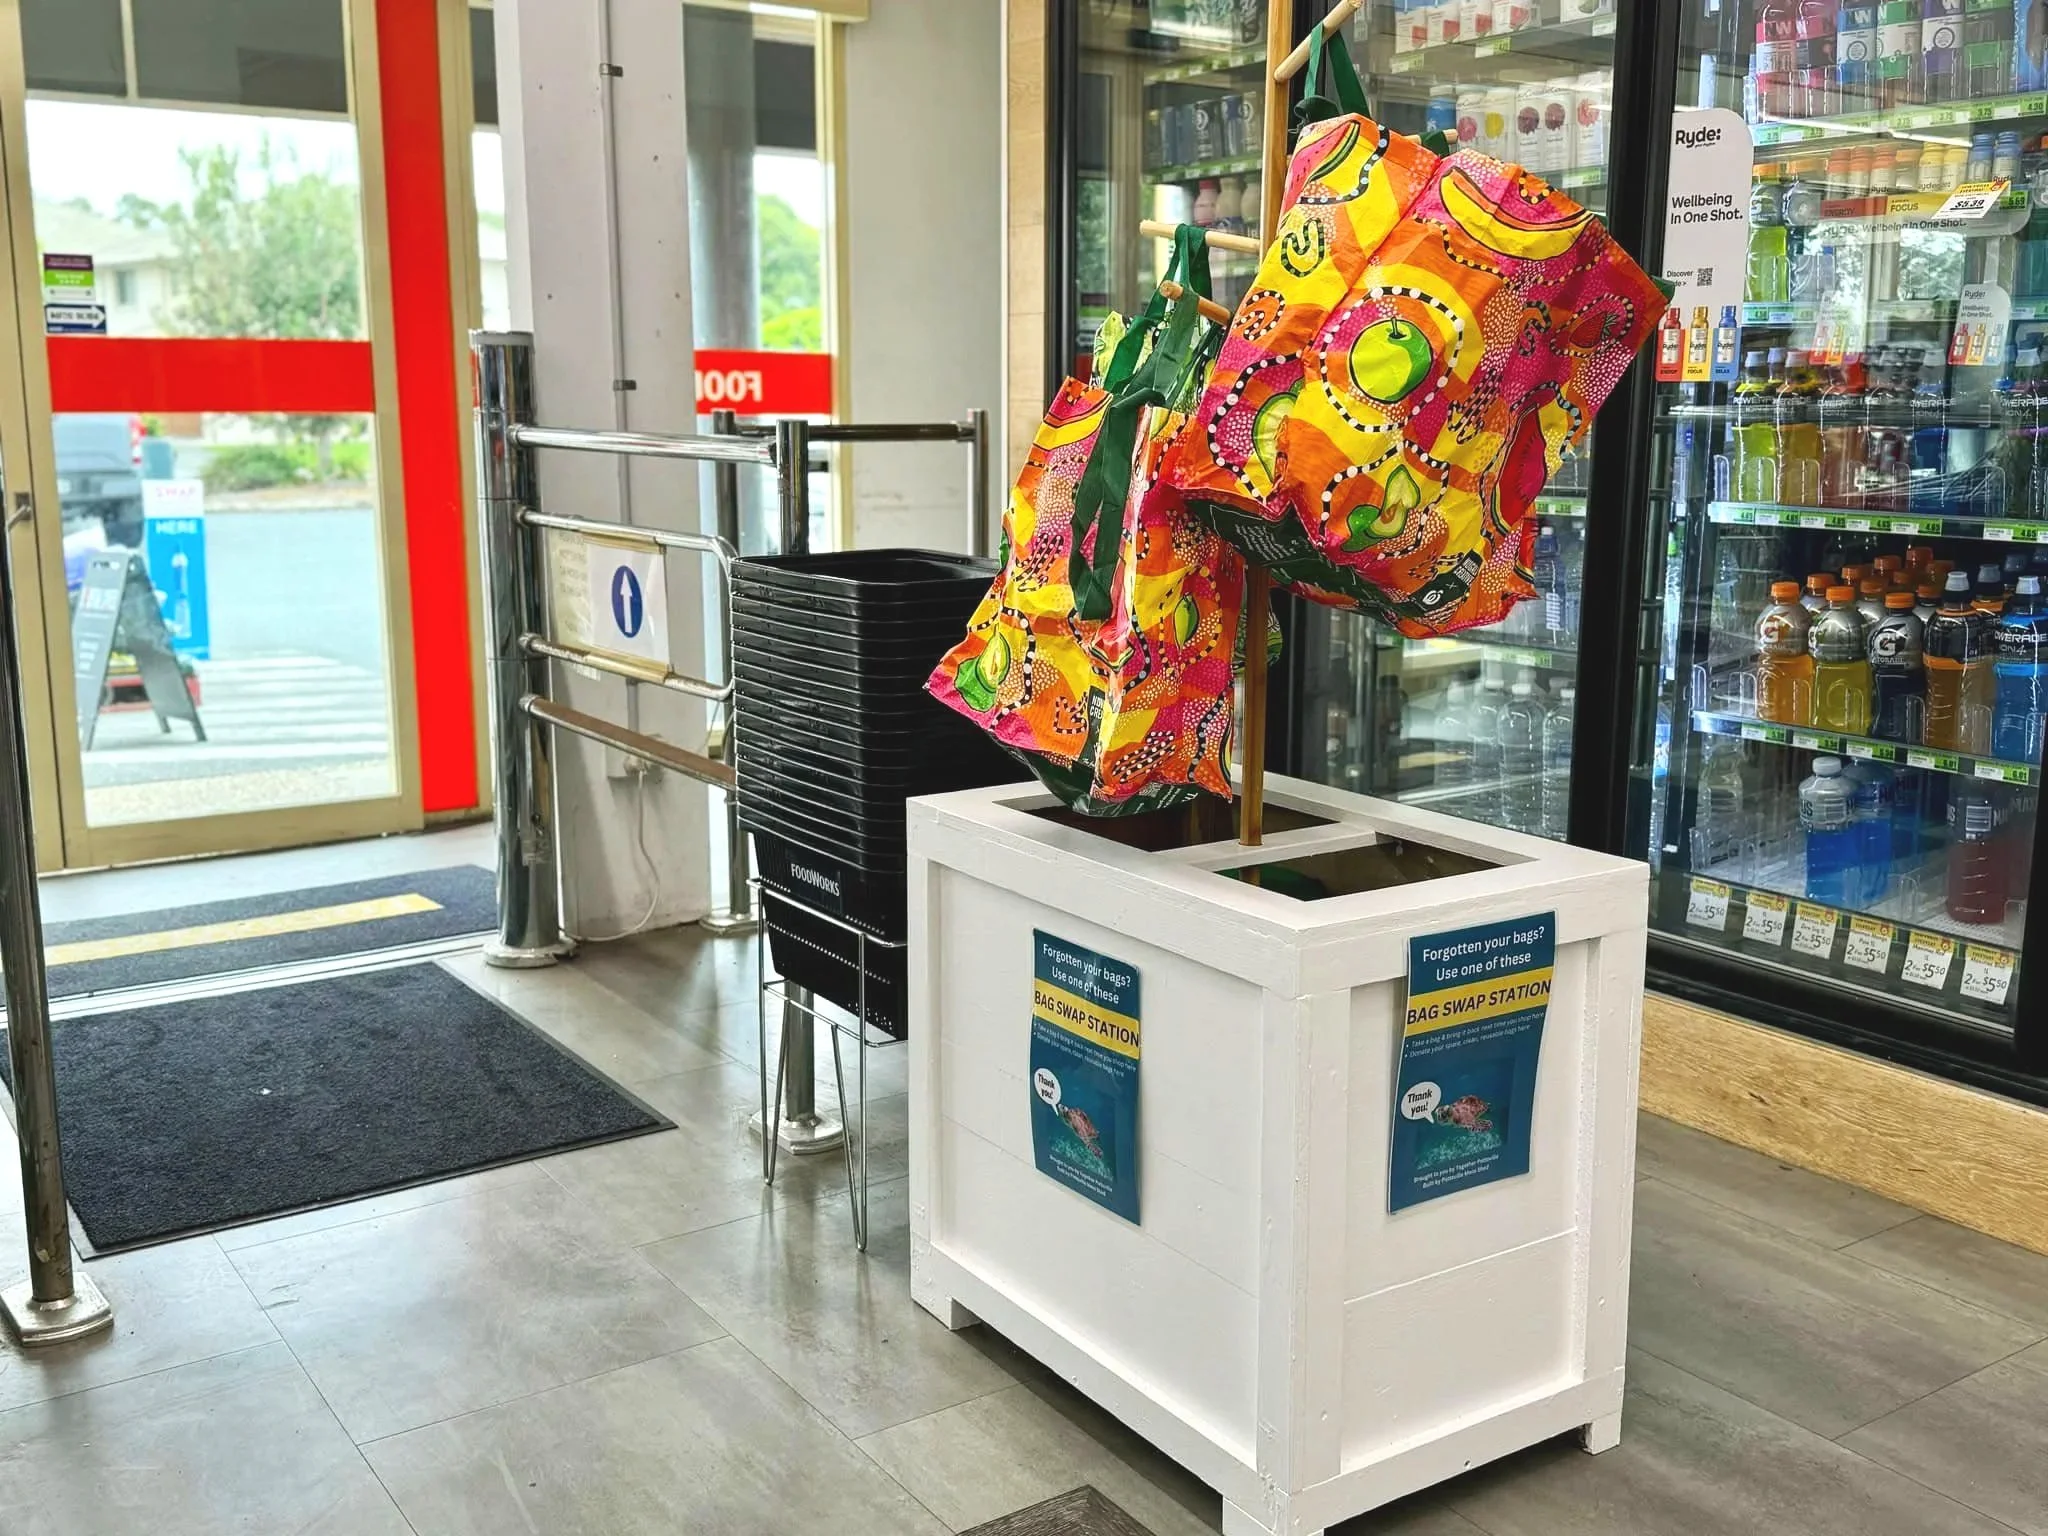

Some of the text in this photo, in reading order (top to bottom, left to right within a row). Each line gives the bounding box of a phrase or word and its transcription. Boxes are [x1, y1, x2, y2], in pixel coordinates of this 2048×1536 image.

[1672, 193, 1733, 208] Wellbeing
[1890, 202, 1920, 213] FOCUS
[1671, 208, 1743, 224] In One Shot.
[1862, 222, 1908, 234] Wellbeing
[1909, 221, 1918, 229] In
[1919, 221, 1939, 229] One
[1939, 218, 1968, 228] Shot.
[1667, 270, 1693, 278] Discover
[790, 863, 841, 897] FOODWORKS
[1689, 902, 1696, 912] 2
[1746, 916, 1753, 927] 2
[1423, 926, 1545, 962] Forgotten your bags?
[1794, 931, 1802, 941] 2
[1847, 944, 1855, 955] 2
[1043, 943, 1131, 988] Forgotten your bags?
[1436, 953, 1531, 981] Use one of these
[1905, 959, 1913, 970] 2
[1052, 966, 1119, 1004] Use one of these
[1964, 973, 1973, 985] 2
[1407, 979, 1551, 1025] BAG SWAP STATION
[1034, 990, 1139, 1048] BAG SWAP STATION
[1038, 1073, 1055, 1089] Thank
[1408, 1088, 1432, 1104] Thank
[1411, 1101, 1429, 1118] you!
